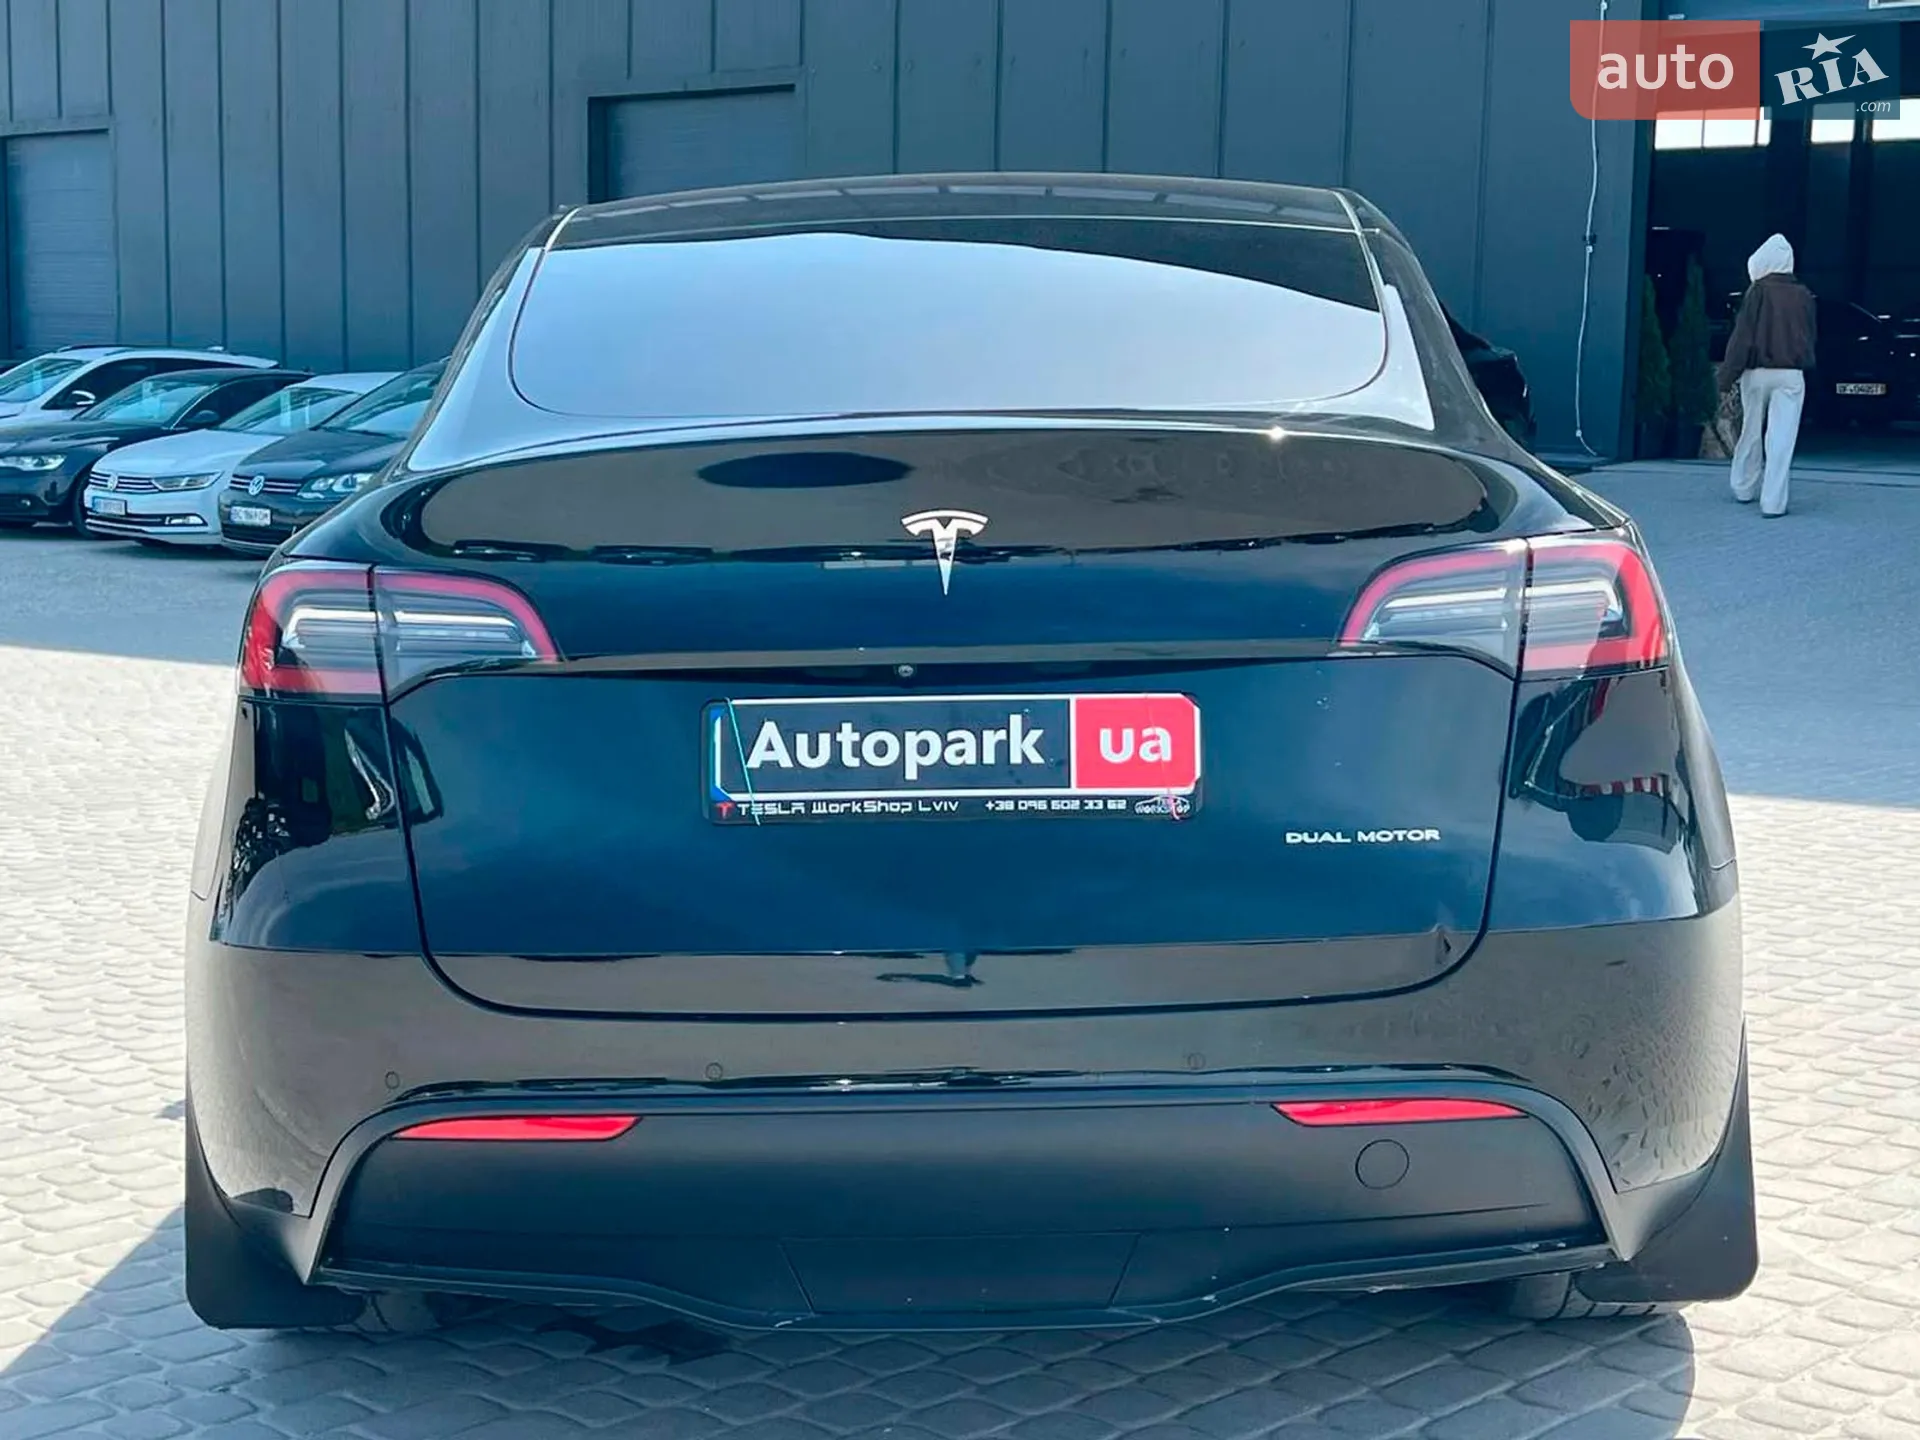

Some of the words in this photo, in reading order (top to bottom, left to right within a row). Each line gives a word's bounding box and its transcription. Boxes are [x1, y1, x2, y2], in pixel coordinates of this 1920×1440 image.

[746, 713, 1045, 780] Autopark
[1099, 726, 1173, 764] ua
[737, 802, 806, 816] TESLA
[1285, 831, 1352, 844] DUAL
[1356, 828, 1441, 842] MOTOR
